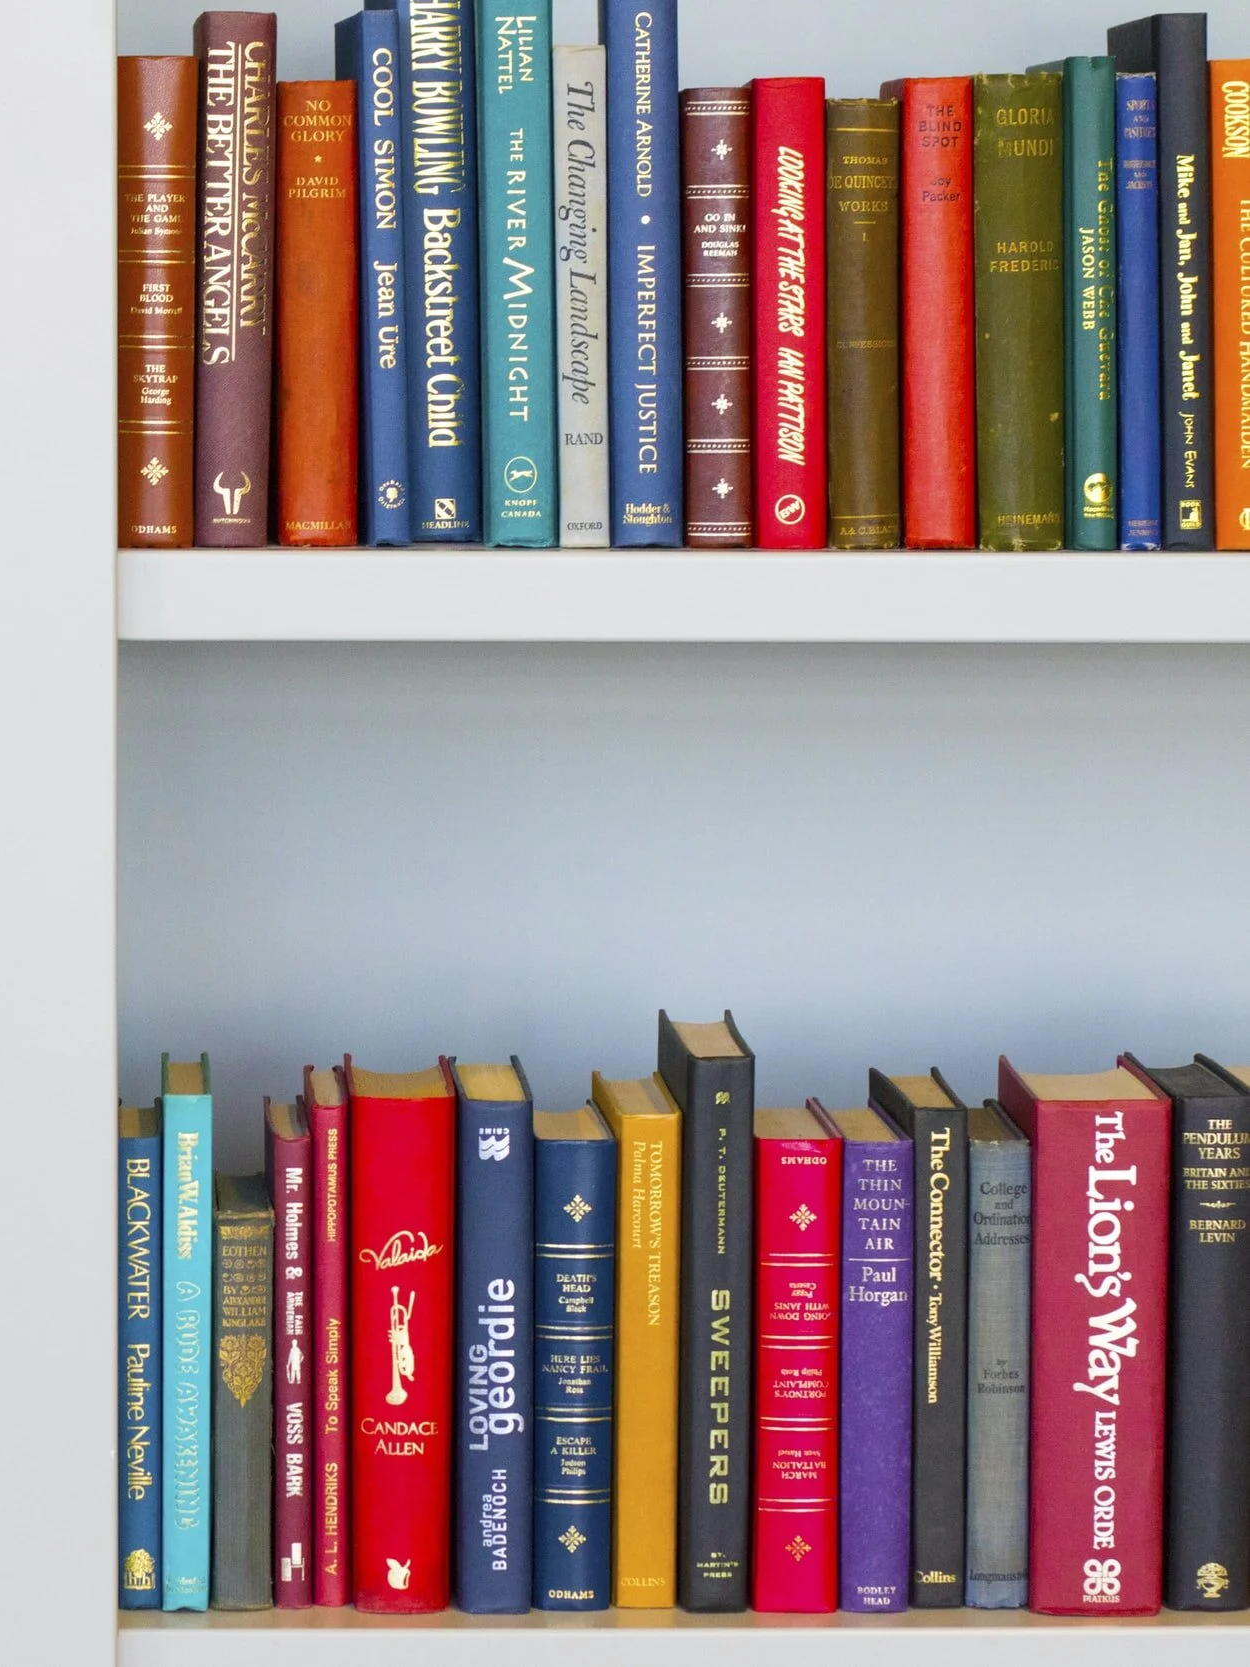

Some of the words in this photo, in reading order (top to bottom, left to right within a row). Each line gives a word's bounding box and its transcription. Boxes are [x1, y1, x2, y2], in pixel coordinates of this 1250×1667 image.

[207, 41, 235, 106] THE
[495, 16, 513, 94] NATTEL
[516, 16, 537, 81] LILIAN
[635, 11, 653, 115] CATHERINE
[306, 101, 330, 111] NO
[373, 47, 393, 126] COOL
[566, 81, 596, 131] The
[926, 106, 954, 116] THE
[284, 115, 351, 127] COMMON
[291, 131, 344, 142] GLORY
[509, 127, 523, 162] THE
[919, 121, 961, 132] BLIND
[922, 137, 958, 147] SPOT
[205, 113, 234, 236] BETTER
[635, 120, 653, 197] ARNOLD
[1176, 154, 1194, 198] Mike
[374, 140, 396, 229] SIMON
[558, 139, 598, 265] Changing
[506, 170, 526, 251] RIVER
[694, 224, 716, 233] AND
[719, 224, 746, 233] SINK!
[704, 213, 720, 222] GO
[723, 213, 736, 222] IN
[1178, 203, 1190, 225] and
[1176, 229, 1197, 266] Jan,
[202, 241, 232, 366] ANGELS
[374, 260, 398, 319] Jean
[423, 207, 460, 369] Backstreet
[636, 245, 657, 376] IMPERFECT
[1177, 272, 1198, 316] John
[378, 325, 398, 369] Ure
[502, 257, 535, 422] MIDNIGHT
[562, 267, 599, 405] Landscape
[1181, 321, 1193, 344] and
[1179, 350, 1199, 400] Janet
[426, 373, 466, 448] Child
[635, 383, 658, 474] JUSTICE
[565, 433, 603, 445] RAND
[327, 1128, 338, 1160] PRESS
[633, 1141, 646, 1183] Palma
[930, 1127, 950, 1170] The
[1095, 1111, 1126, 1164] The
[285, 1167, 303, 1194] Mr.
[859, 1178, 902, 1190] THIN
[863, 1159, 897, 1172] THE
[327, 1163, 338, 1242] HIPPOPOTAMUS
[633, 1188, 645, 1249] Harcourt
[649, 1141, 662, 1248] TOMORROW'S
[854, 1198, 910, 1210] MOUN-
[127, 1159, 151, 1319] BLACKWATER
[285, 1202, 303, 1260] Holmes
[859, 1218, 901, 1230] TAIN
[865, 1238, 894, 1250] AIR
[928, 1172, 950, 1287] Connector
[1074, 1165, 1137, 1297] Lion's
[1190, 1220, 1245, 1230] BERNARD
[1200, 1233, 1235, 1243] LEVIN
[285, 1266, 303, 1279] &
[359, 1230, 444, 1270] Valaida
[862, 1267, 896, 1282] Paul
[648, 1251, 661, 1326] TREASON
[849, 1286, 908, 1306] Horgan
[927, 1293, 942, 1327] Tony
[478, 1278, 525, 1435] geordie
[927, 1326, 942, 1404] Williamson
[1073, 1297, 1140, 1406] Way
[127, 1343, 151, 1420] Pauline
[469, 1344, 488, 1450] LOVING
[709, 1290, 731, 1505] SWEEPERS
[286, 1402, 303, 1445] VOSS
[361, 1418, 438, 1435] CANDACE
[375, 1439, 424, 1455] ALLEN
[1094, 1411, 1117, 1481] LEWIS
[127, 1425, 152, 1500] Neville
[286, 1453, 303, 1498] BARK
[480, 1494, 493, 1547] andrea
[492, 1469, 507, 1570] BADENOCH
[1093, 1485, 1116, 1550] ORDE
